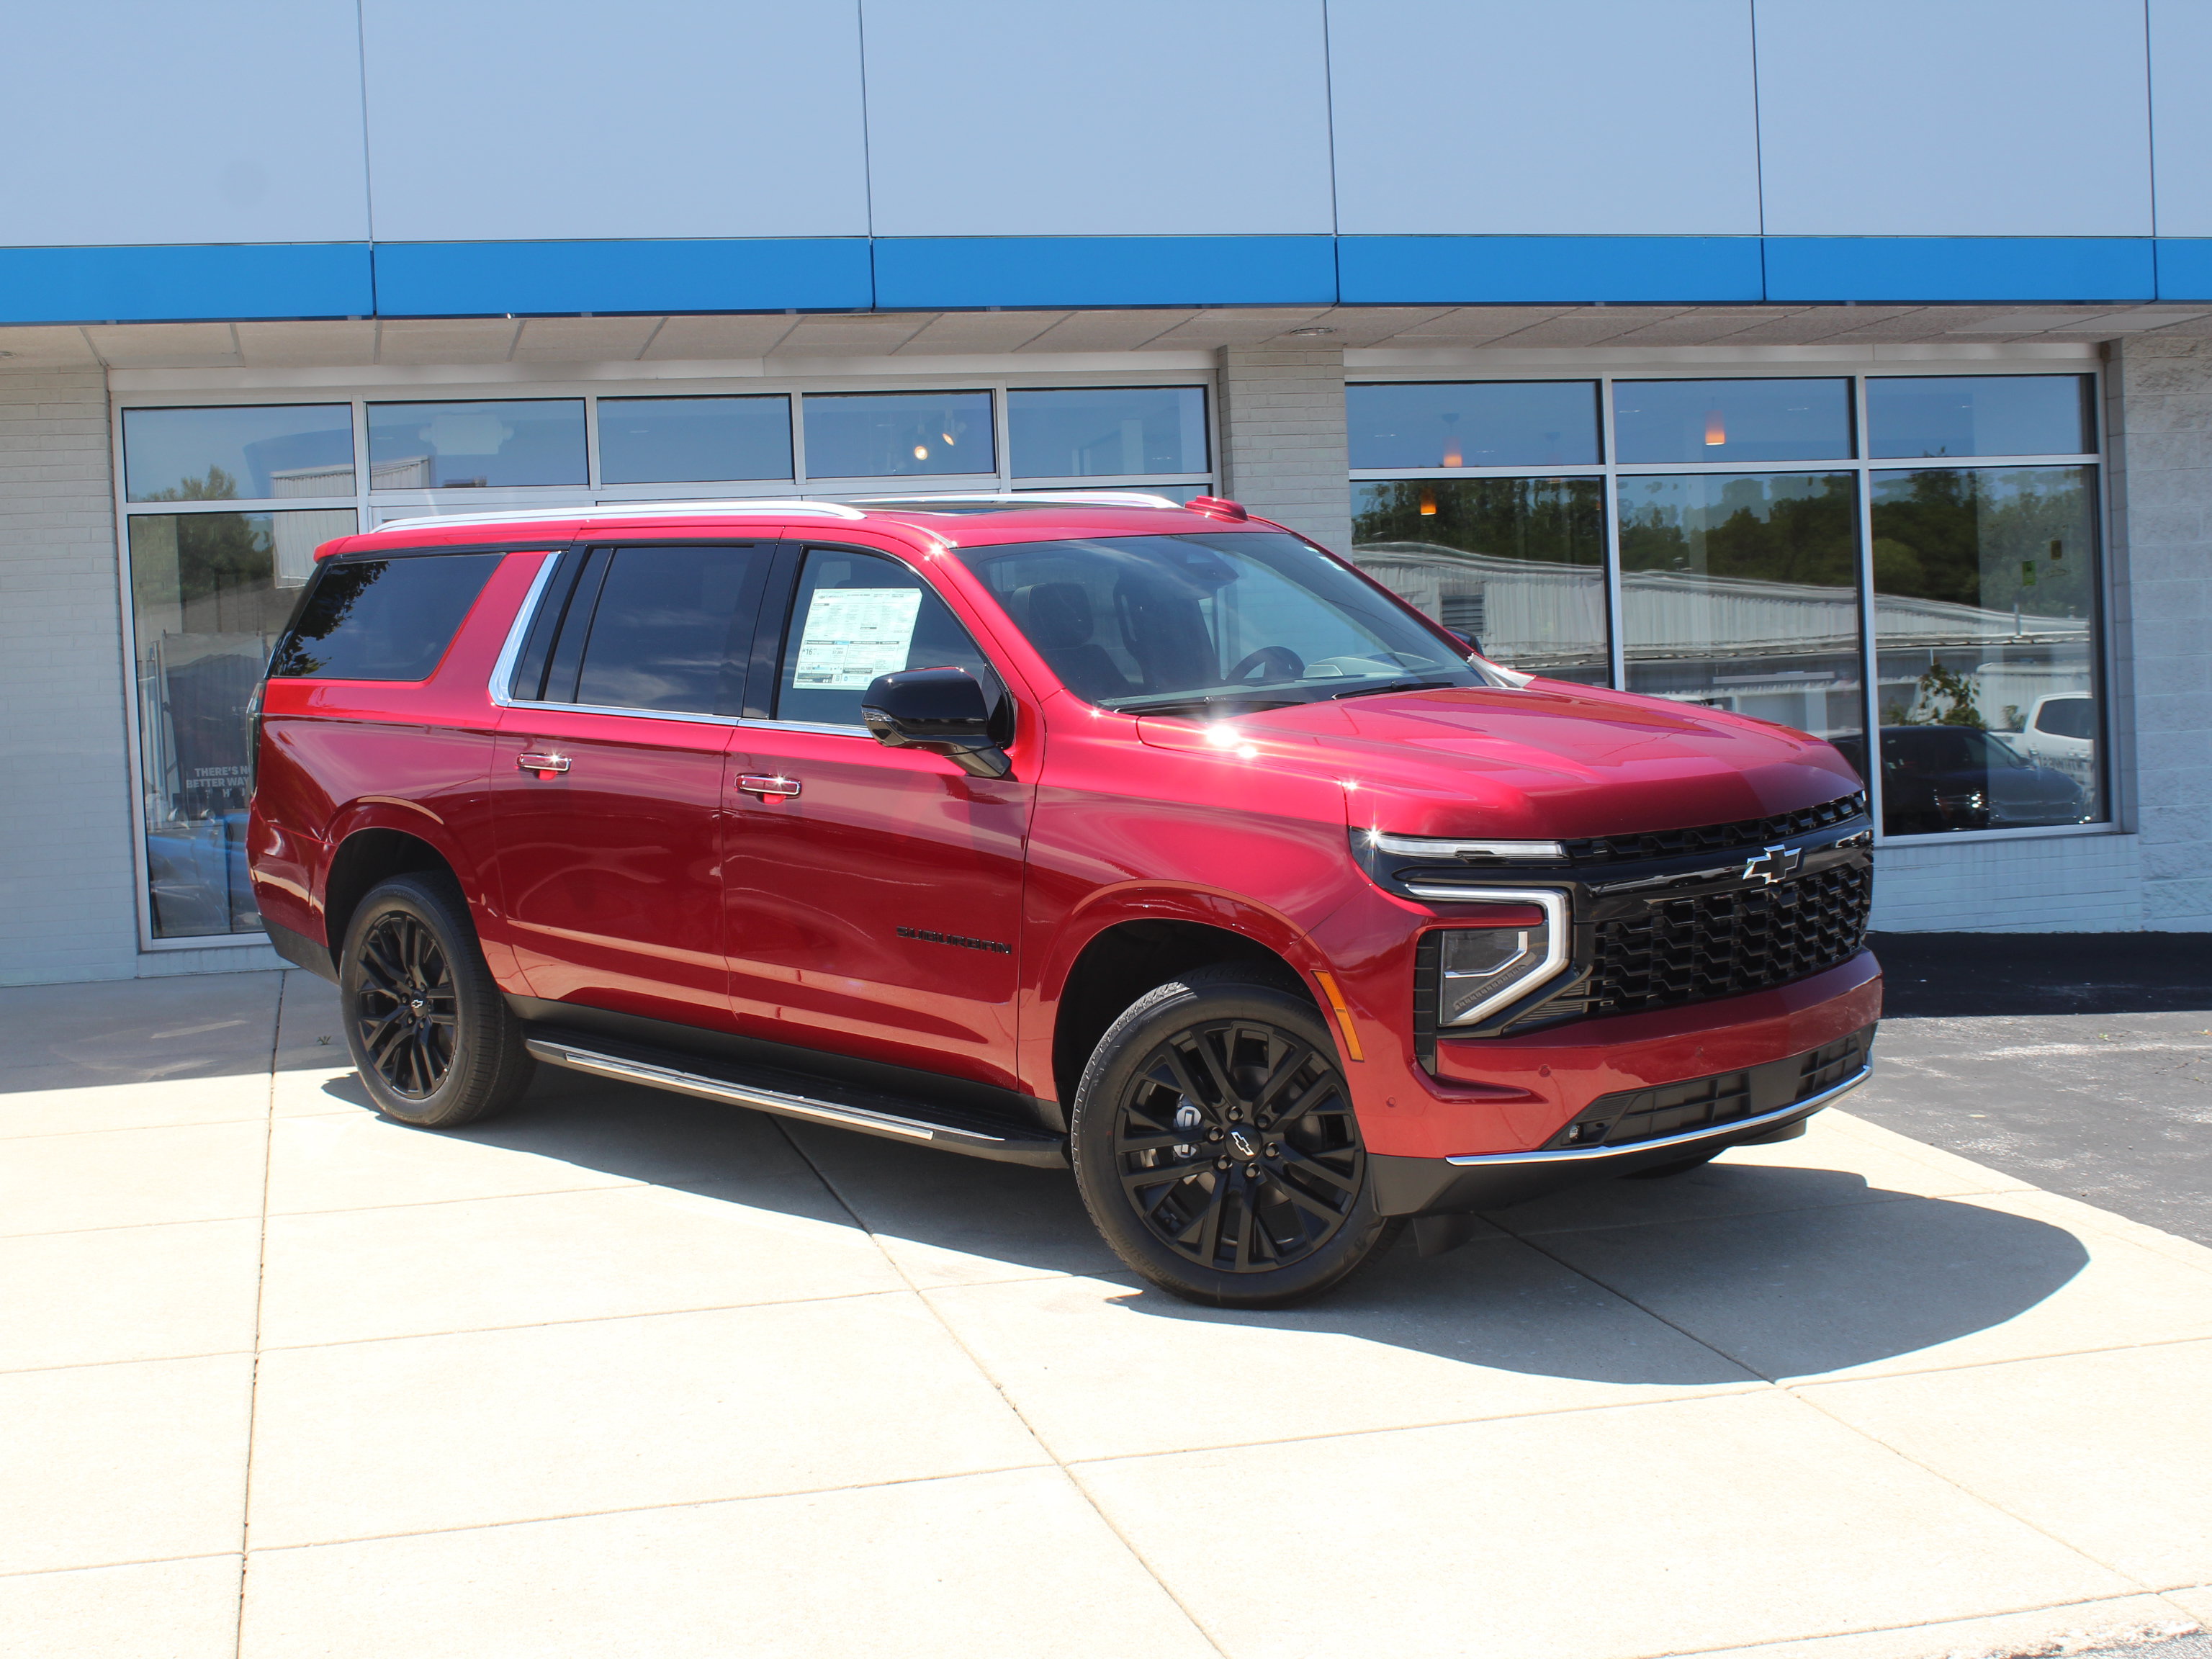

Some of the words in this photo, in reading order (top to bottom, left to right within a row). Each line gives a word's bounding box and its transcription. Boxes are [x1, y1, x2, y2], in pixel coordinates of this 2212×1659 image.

[194, 766, 239, 777] THERE'S
[186, 778, 225, 788] BETTER
[896, 926, 1012, 955] SUBURBAN
